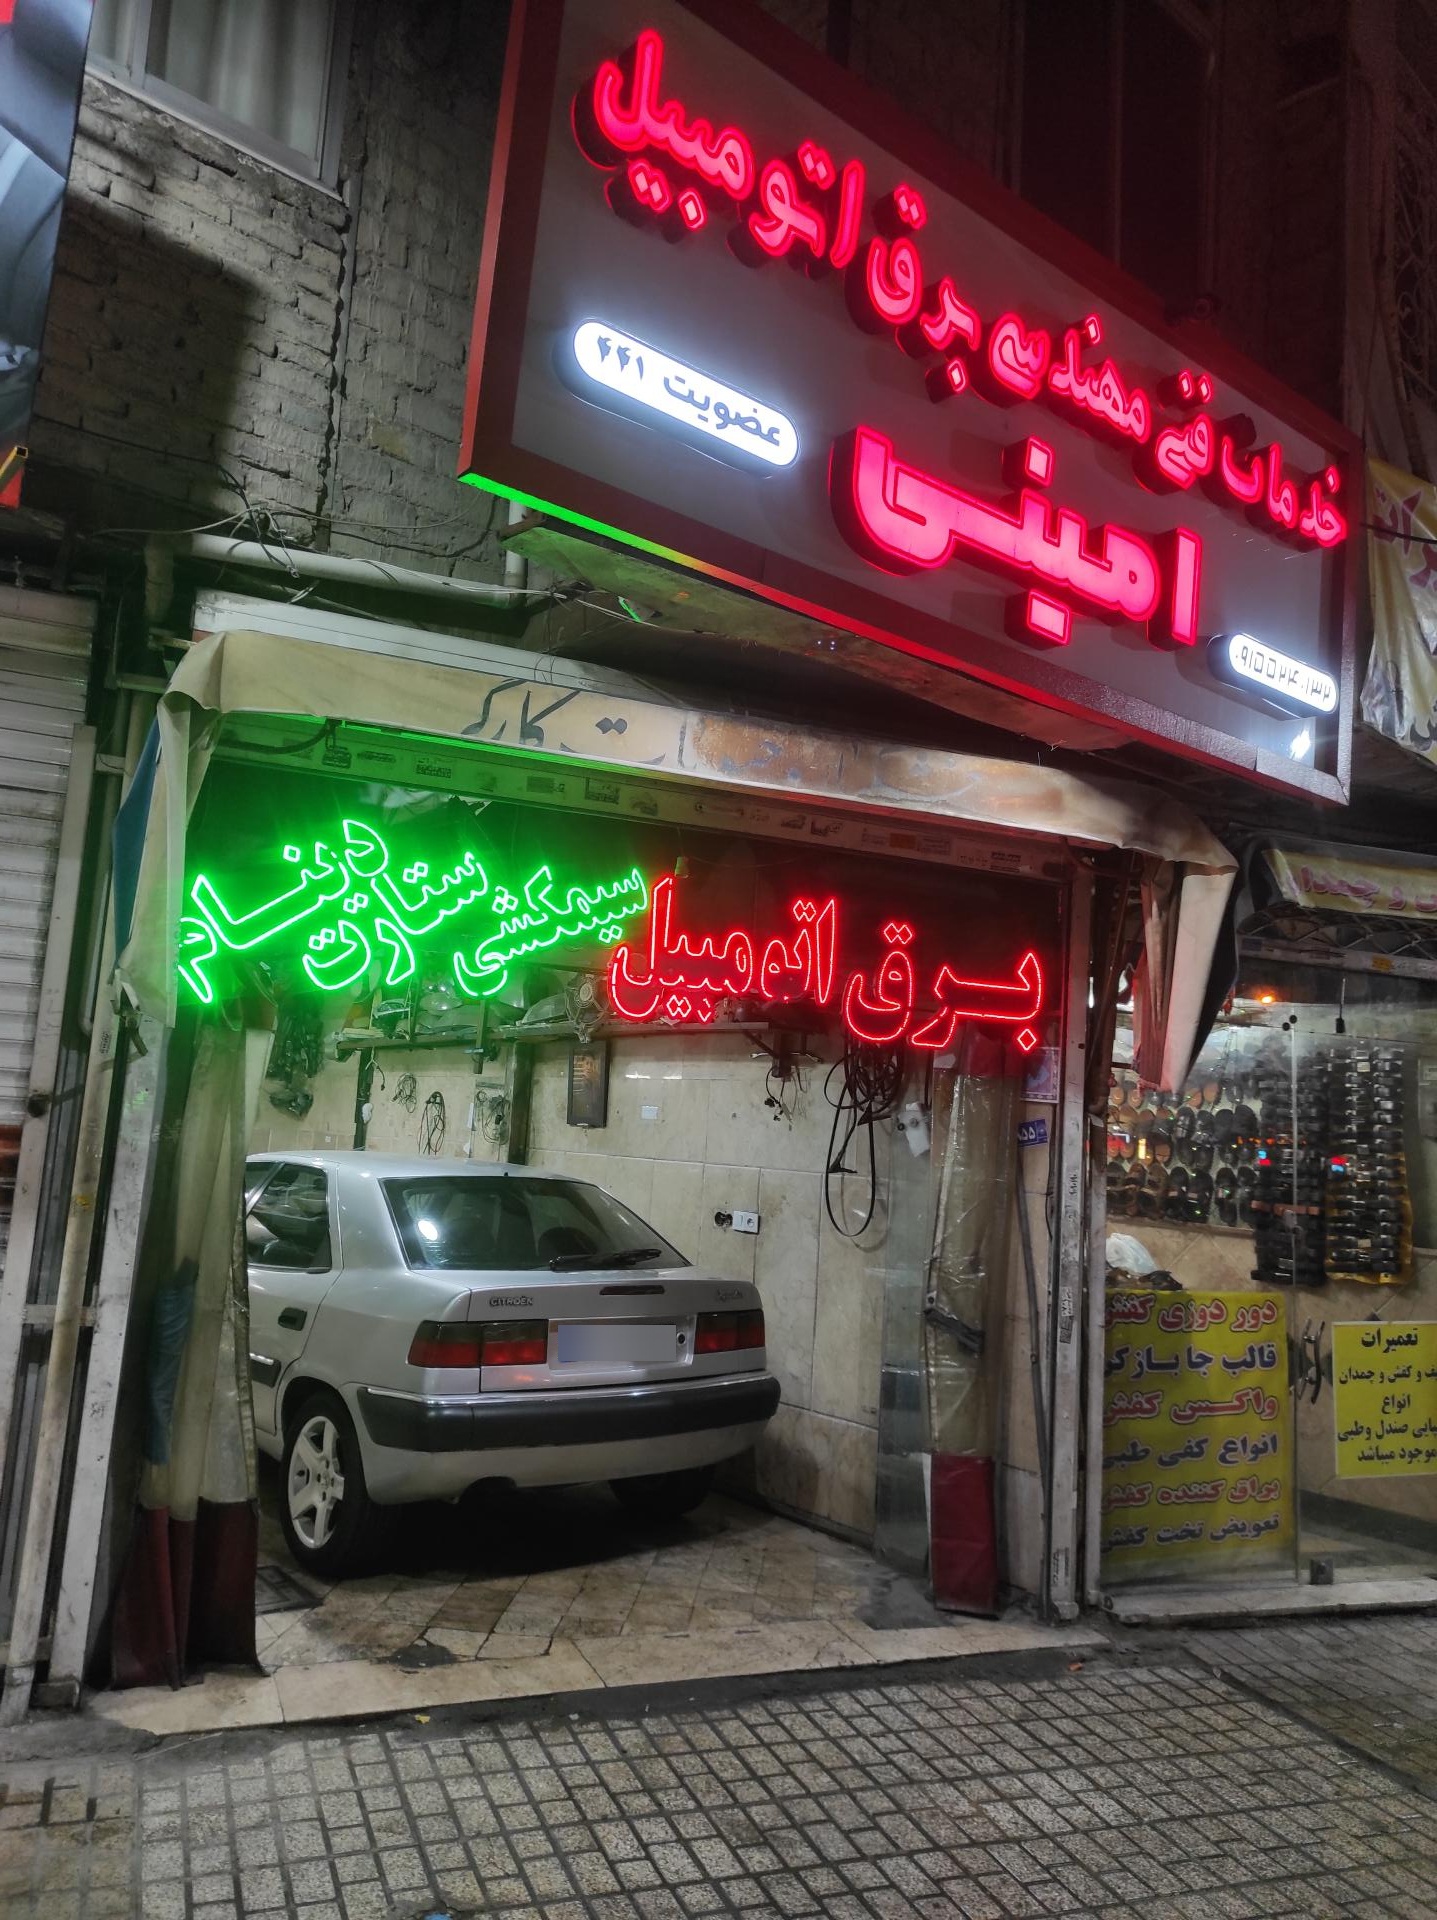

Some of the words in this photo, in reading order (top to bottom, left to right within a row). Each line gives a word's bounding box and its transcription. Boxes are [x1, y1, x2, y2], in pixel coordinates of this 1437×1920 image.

[594, 28, 866, 268] اتومبیل
[867, 185, 981, 393] برق
[989, 314, 1150, 443] مهندسی
[664, 375, 780, 447] عضویت
[1155, 369, 1213, 490] فنی
[1222, 436, 1347, 546] خدمات
[853, 425, 1202, 647] امینی
[178, 818, 389, 1004] دینام
[611, 874, 836, 1022] اتومبیل
[845, 921, 1042, 1052] برق
[1158, 1298, 1228, 1332] دوزی
[1230, 1300, 1278, 1332] دور
[1361, 1327, 1419, 1353] تعمیرات
[1221, 1343, 1278, 1376] قالب
[1339, 1366, 1375, 1385] چمدان
[1387, 1364, 1412, 1383] کفش
[1416, 1371, 1422, 1382] و
[1171, 1386, 1279, 1424] واکس
[1381, 1393, 1411, 1414] انواع
[1375, 1419, 1409, 1440] صندل
[1156, 1436, 1209, 1470] کفی
[1217, 1432, 1278, 1468] انواع
[1398, 1445, 1437, 1464] موجود
[1157, 1480, 1227, 1505] کننده
[1228, 1475, 1280, 1503] براق
[1156, 1520, 1205, 1546] تخت
[1208, 1513, 1280, 1542] تعویض
